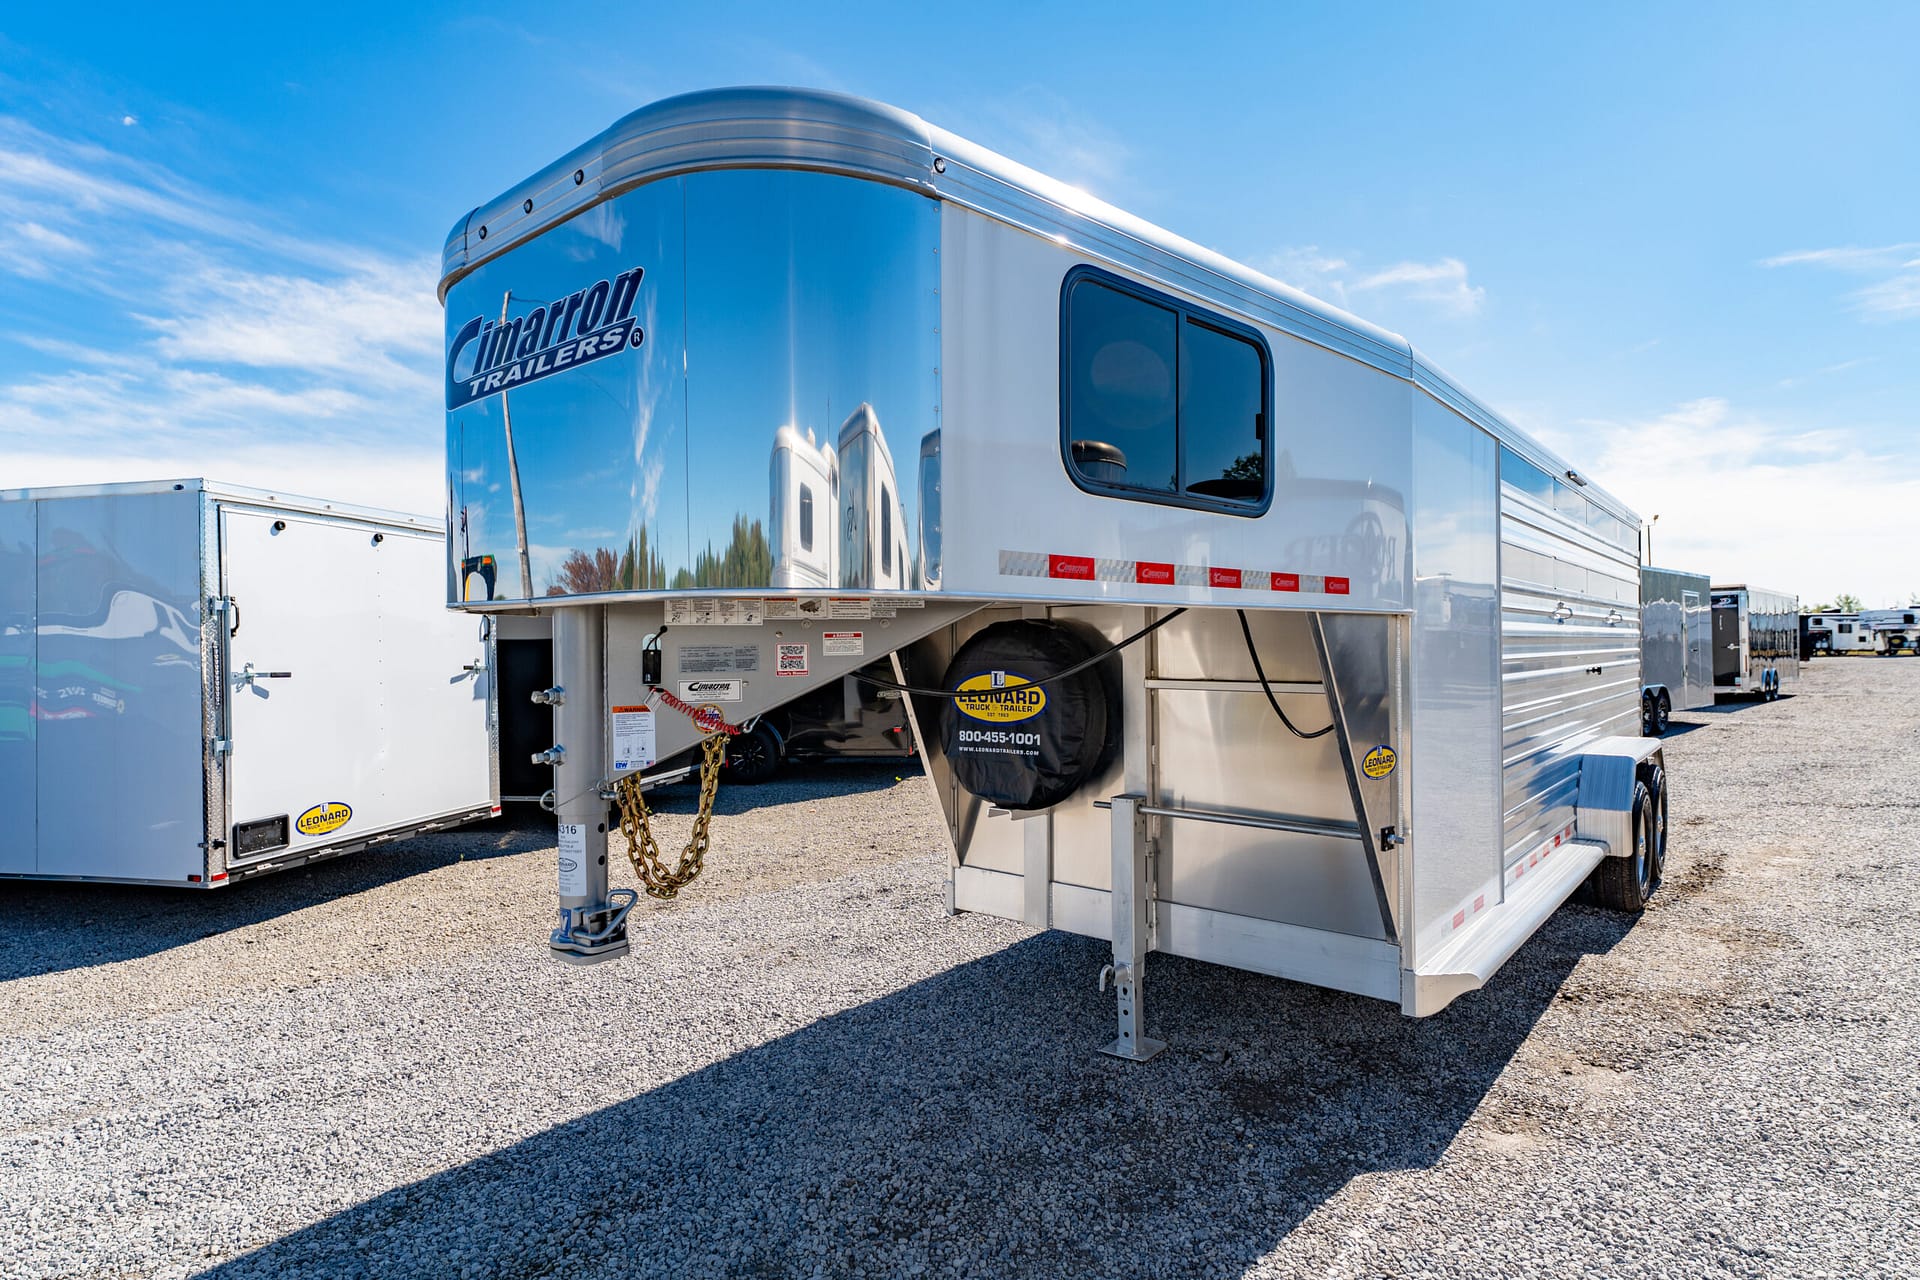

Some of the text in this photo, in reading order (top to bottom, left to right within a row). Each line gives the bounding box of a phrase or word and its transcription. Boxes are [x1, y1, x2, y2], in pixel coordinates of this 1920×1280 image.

[446, 267, 644, 386] Cimarron
[469, 326, 625, 397] TRAILERS
[688, 682, 731, 691] Cimarron
[959, 689, 1040, 705] LEONARD
[959, 730, 1041, 745] 800-455-1001
[1365, 755, 1394, 768] LEONARD
[300, 809, 348, 827] LEONARD
